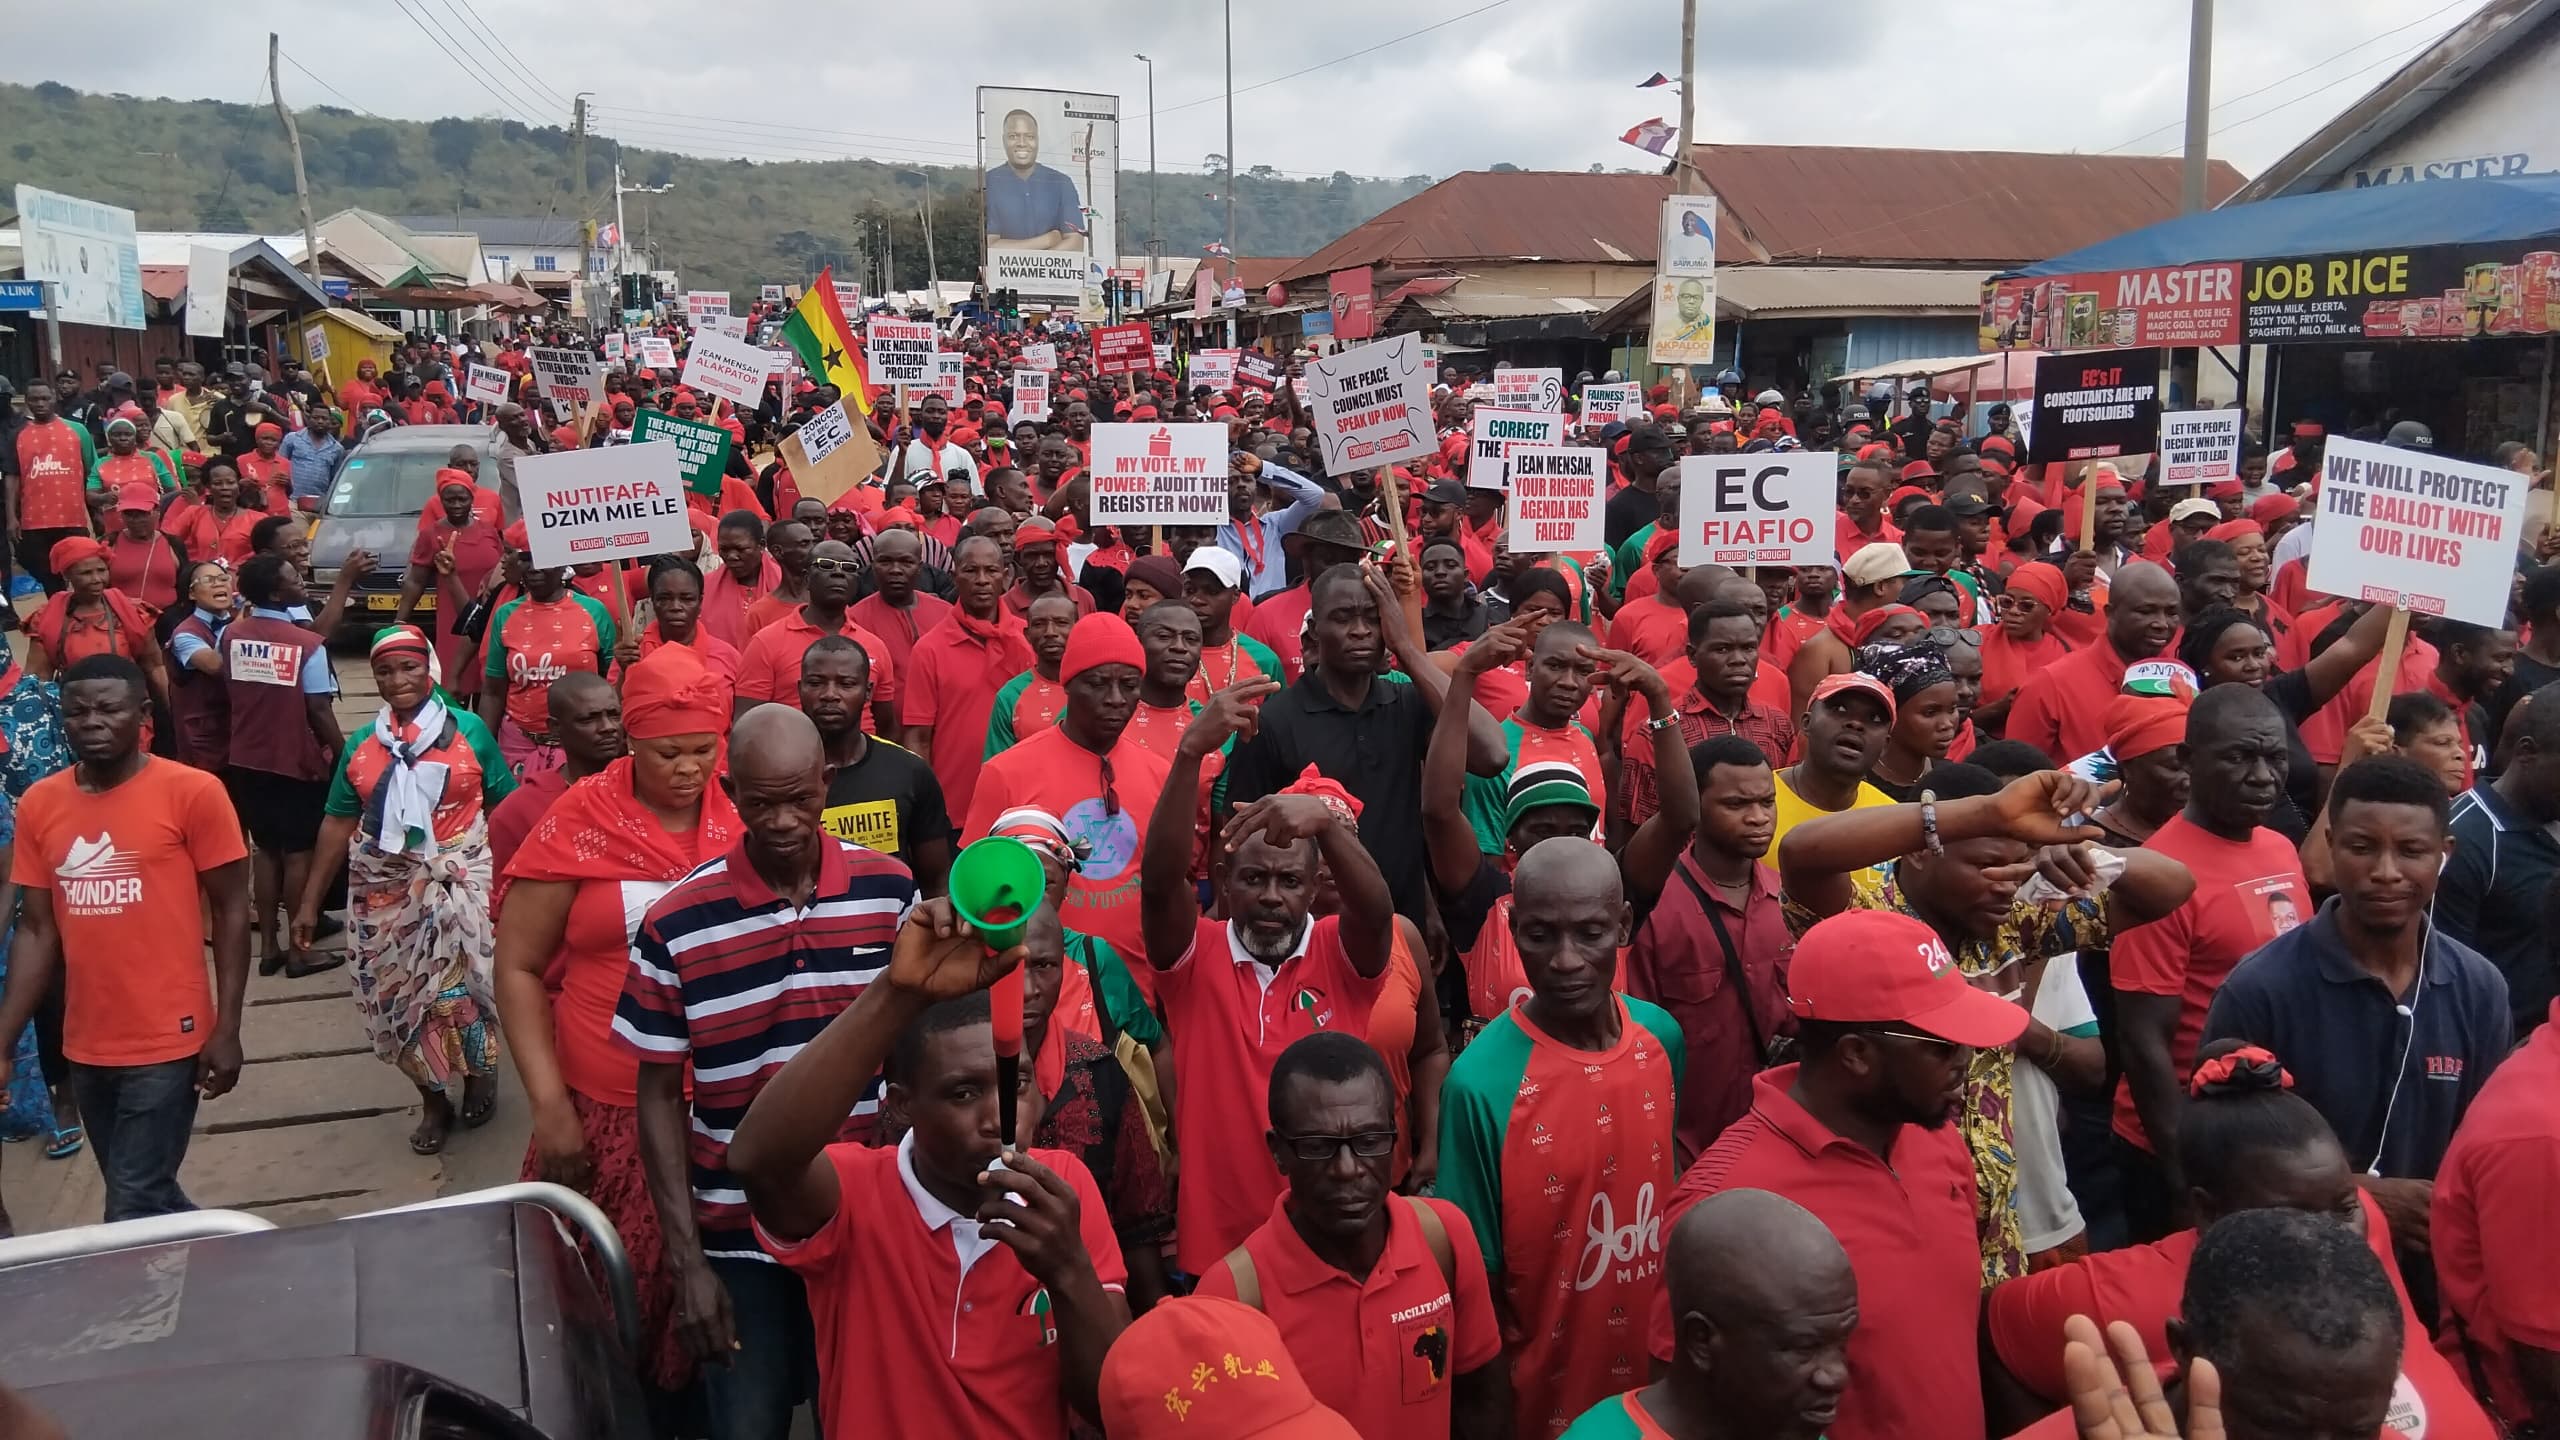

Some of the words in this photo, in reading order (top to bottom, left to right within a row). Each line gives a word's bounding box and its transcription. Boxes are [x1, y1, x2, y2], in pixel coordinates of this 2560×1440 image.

[2355, 153, 2529, 189] MASTER
[999, 256, 1073, 268] MAWULORM
[1000, 267, 1047, 279] KWAME
[1048, 268, 1084, 280] KLUTS
[2247, 262, 2315, 302] JOB
[2326, 255, 2409, 298] RICE
[9, 285, 35, 297] LINK
[2117, 267, 2233, 307] MASTER
[2146, 310, 2172, 322] MAGIC
[2173, 309, 2191, 321] RICE,
[2193, 308, 2211, 319] ROSE
[2249, 305, 2282, 316] FESTIVA
[2283, 303, 2307, 314] MILK,
[2310, 301, 2348, 313] EXERTA,
[2146, 321, 2172, 332] MAGIC
[2197, 319, 2210, 330] CIC
[2210, 318, 2229, 330] RICE
[2249, 316, 2274, 327] TASTY
[2276, 315, 2298, 326] TOM,
[2299, 313, 2334, 325] FRYTOL,
[873, 326, 920, 339] WASTEFUL
[921, 327, 932, 339] EC
[2145, 331, 2164, 342] MILO
[2165, 330, 2199, 341] SARDINE
[2199, 329, 2221, 340] JAGO
[2324, 324, 2347, 335] MILK
[2348, 325, 2361, 334] etc
[872, 339, 892, 352] LIKE
[892, 340, 935, 353] NATIONAL
[533, 350, 560, 361] WHERE
[560, 351, 575, 362] ARE
[575, 353, 590, 364] THE
[699, 347, 722, 360] JEAN
[723, 357, 760, 376] MENSAH
[879, 352, 929, 366] CATHEDRAL
[537, 361, 563, 374] STOLEN
[695, 357, 759, 385] ALAKPATOR
[885, 366, 923, 380] PROJECT
[950, 362, 962, 374] THE
[1204, 361, 1217, 370] YOUR
[944, 376, 957, 387] THE
[1020, 375, 1030, 387] THE
[1191, 370, 1230, 379] INCOMPETENCE
[1340, 377, 1359, 393] THE
[1360, 366, 1390, 388] PEACE
[2081, 368, 2108, 388] EC's
[2108, 367, 2123, 386] IT
[549, 385, 591, 401] THIEVES!
[1332, 390, 1375, 415] COUNCIL
[1374, 383, 1404, 406] MUST
[1498, 394, 1510, 402] TOO
[1528, 393, 1540, 402] FOR
[1586, 389, 1625, 402] FAIRNESS
[2043, 390, 2114, 408] CONSULTANTS
[2114, 387, 2135, 403] ARE
[2134, 385, 2155, 401] NPP
[1590, 401, 1621, 412] MUST
[2062, 404, 2136, 424] FOOTSOLDIERS
[802, 405, 838, 436] ZONGOS
[830, 412, 844, 425] YOU
[1336, 416, 1368, 434] SPEAK
[1367, 412, 1382, 427] UP
[1382, 402, 1408, 422] NOW
[647, 417, 664, 431] THE
[664, 420, 696, 439] PEOPLE
[695, 427, 723, 444] MUST
[1488, 419, 1550, 441] CORRECT
[2171, 422, 2185, 436] LET
[2186, 422, 2201, 435] THE
[2202, 420, 2232, 434] PEOPLE
[679, 436, 697, 453] NOT
[814, 424, 841, 450] EC
[2164, 437, 2195, 450] DECIDE
[2195, 435, 2216, 449] WHO
[2216, 434, 2237, 447] THEY
[811, 445, 833, 465] AUDIT
[834, 430, 852, 448] NOW
[1374, 440, 1381, 452] IS
[1476, 440, 1501, 459] THE
[2171, 451, 2196, 464] WANT
[2197, 450, 2209, 462] TO
[2209, 449, 2229, 462] LEAD
[31, 453, 72, 480] John
[1116, 457, 1138, 473] MY
[1141, 457, 1181, 475] VOTE,
[1183, 457, 1207, 473] MY
[1516, 454, 1544, 475] JEAN
[1546, 455, 1594, 478] MENSAH,
[1094, 477, 1151, 494] POWER;
[1152, 476, 1198, 493] AUDIT
[1200, 476, 1228, 493] THE
[1514, 477, 1547, 498] YOUR
[1548, 478, 1595, 498] RIGGING
[1715, 465, 1790, 513] EC
[2327, 455, 2363, 485] WE
[2365, 460, 2414, 493] WILL
[2418, 469, 2510, 511] PROTECT
[546, 480, 661, 509] NUTIFAFA
[1099, 495, 1175, 513] REGISTER
[1176, 495, 1223, 513] NOW!
[1519, 499, 1566, 520] AGENDA
[1567, 500, 1590, 519] HAS
[541, 507, 601, 529] DZIM
[605, 501, 648, 522] MIE
[651, 497, 680, 516] LE
[2327, 486, 2367, 517] THE
[2369, 493, 2445, 532] BALLOT
[2446, 506, 2503, 541] WITH
[1535, 521, 1576, 542] FAILED!
[1703, 517, 1814, 546] FIAFIO
[572, 538, 606, 552] ENOUGH
[606, 537, 614, 546] IS
[615, 532, 650, 547] ENOUGH!
[2358, 524, 2405, 557] OUR
[2406, 541, 2463, 568] LIVES
[1715, 551, 1747, 562] ENOUGH
[1748, 551, 1756, 560] IS
[1756, 549, 1791, 561] ENOUGH!
[2362, 585, 2399, 604] ENOUGH
[2398, 593, 2407, 606] IS
[2407, 593, 2446, 615] ENOUGH!
[239, 642, 295, 662] MMTI
[241, 660, 272, 671] SCHOOL
[511, 651, 568, 689] John
[59, 877, 143, 906] THUNDER
[81, 905, 124, 917] RUNNERS
[1634, 1051, 1648, 1061] NDC
[1584, 1064, 1604, 1076] NDC
[1519, 1083, 1541, 1098] NDC
[1643, 1101, 1656, 1111] NDC
[1597, 1113, 1613, 1126] NDC
[1531, 1133, 1553, 1147] NDC
[1543, 1184, 1566, 1197] NDC
[1575, 1181, 1662, 1292] Joh
